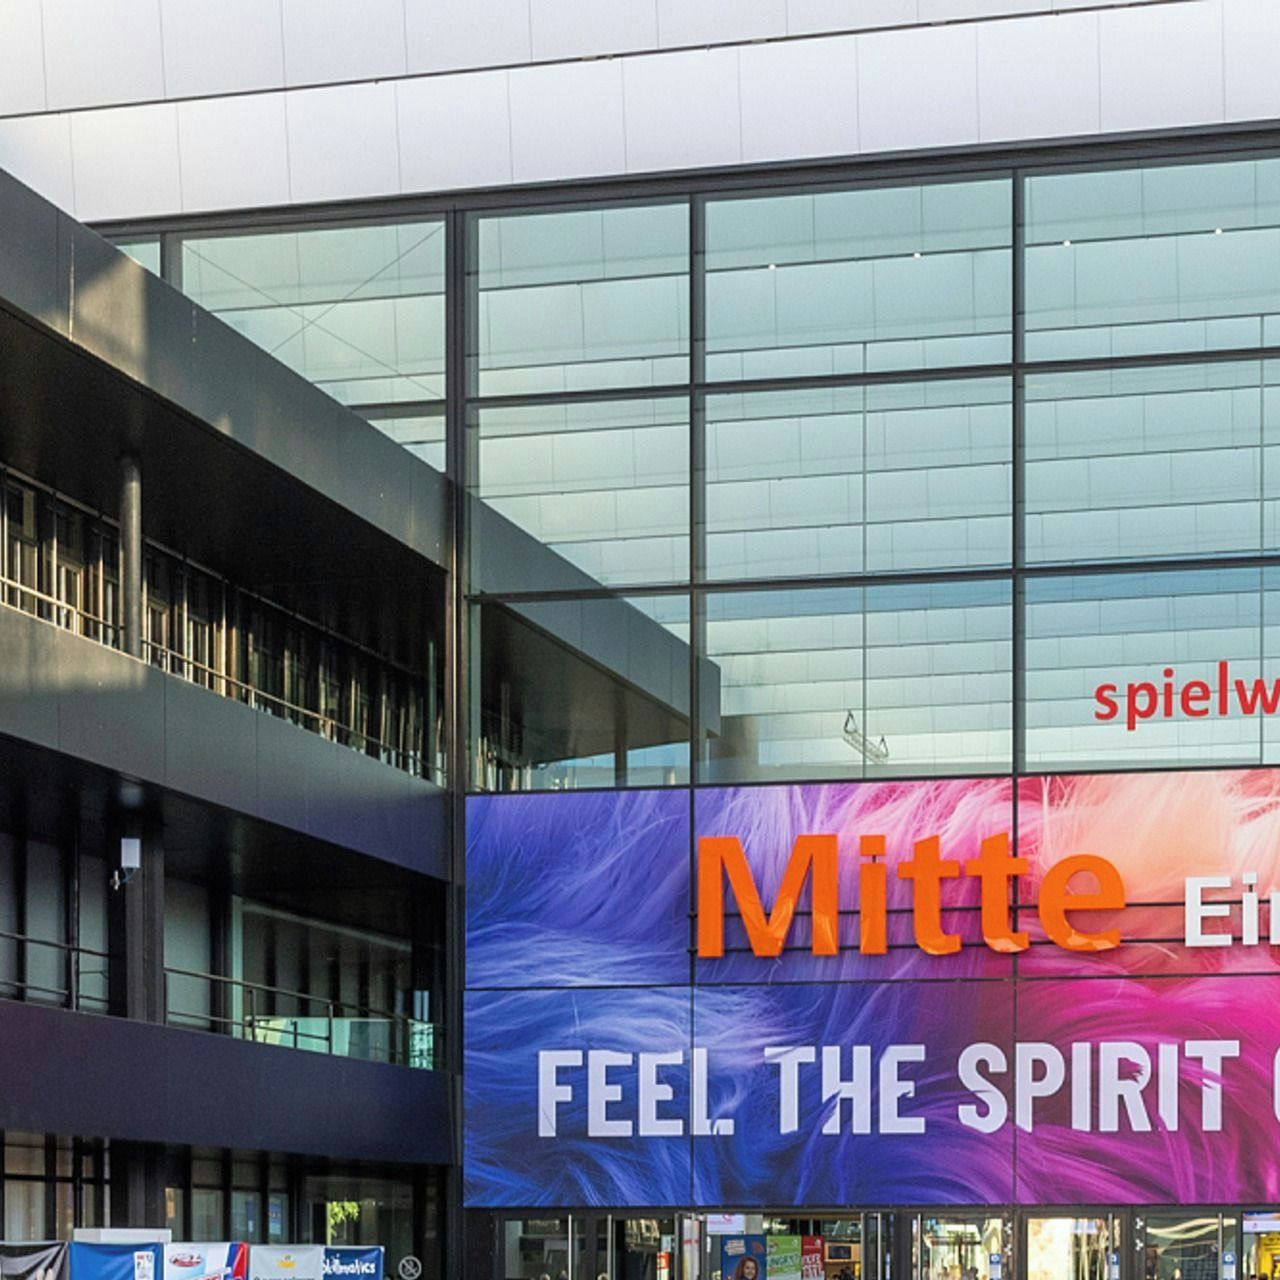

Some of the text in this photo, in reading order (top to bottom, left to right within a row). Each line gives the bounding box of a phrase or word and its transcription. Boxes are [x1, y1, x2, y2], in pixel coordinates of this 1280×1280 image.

[696, 831, 1126, 958] Mitte
[538, 1047, 735, 1138] FEEL
[763, 1043, 926, 1136] THE
[957, 1039, 1242, 1135] SPIRIT
